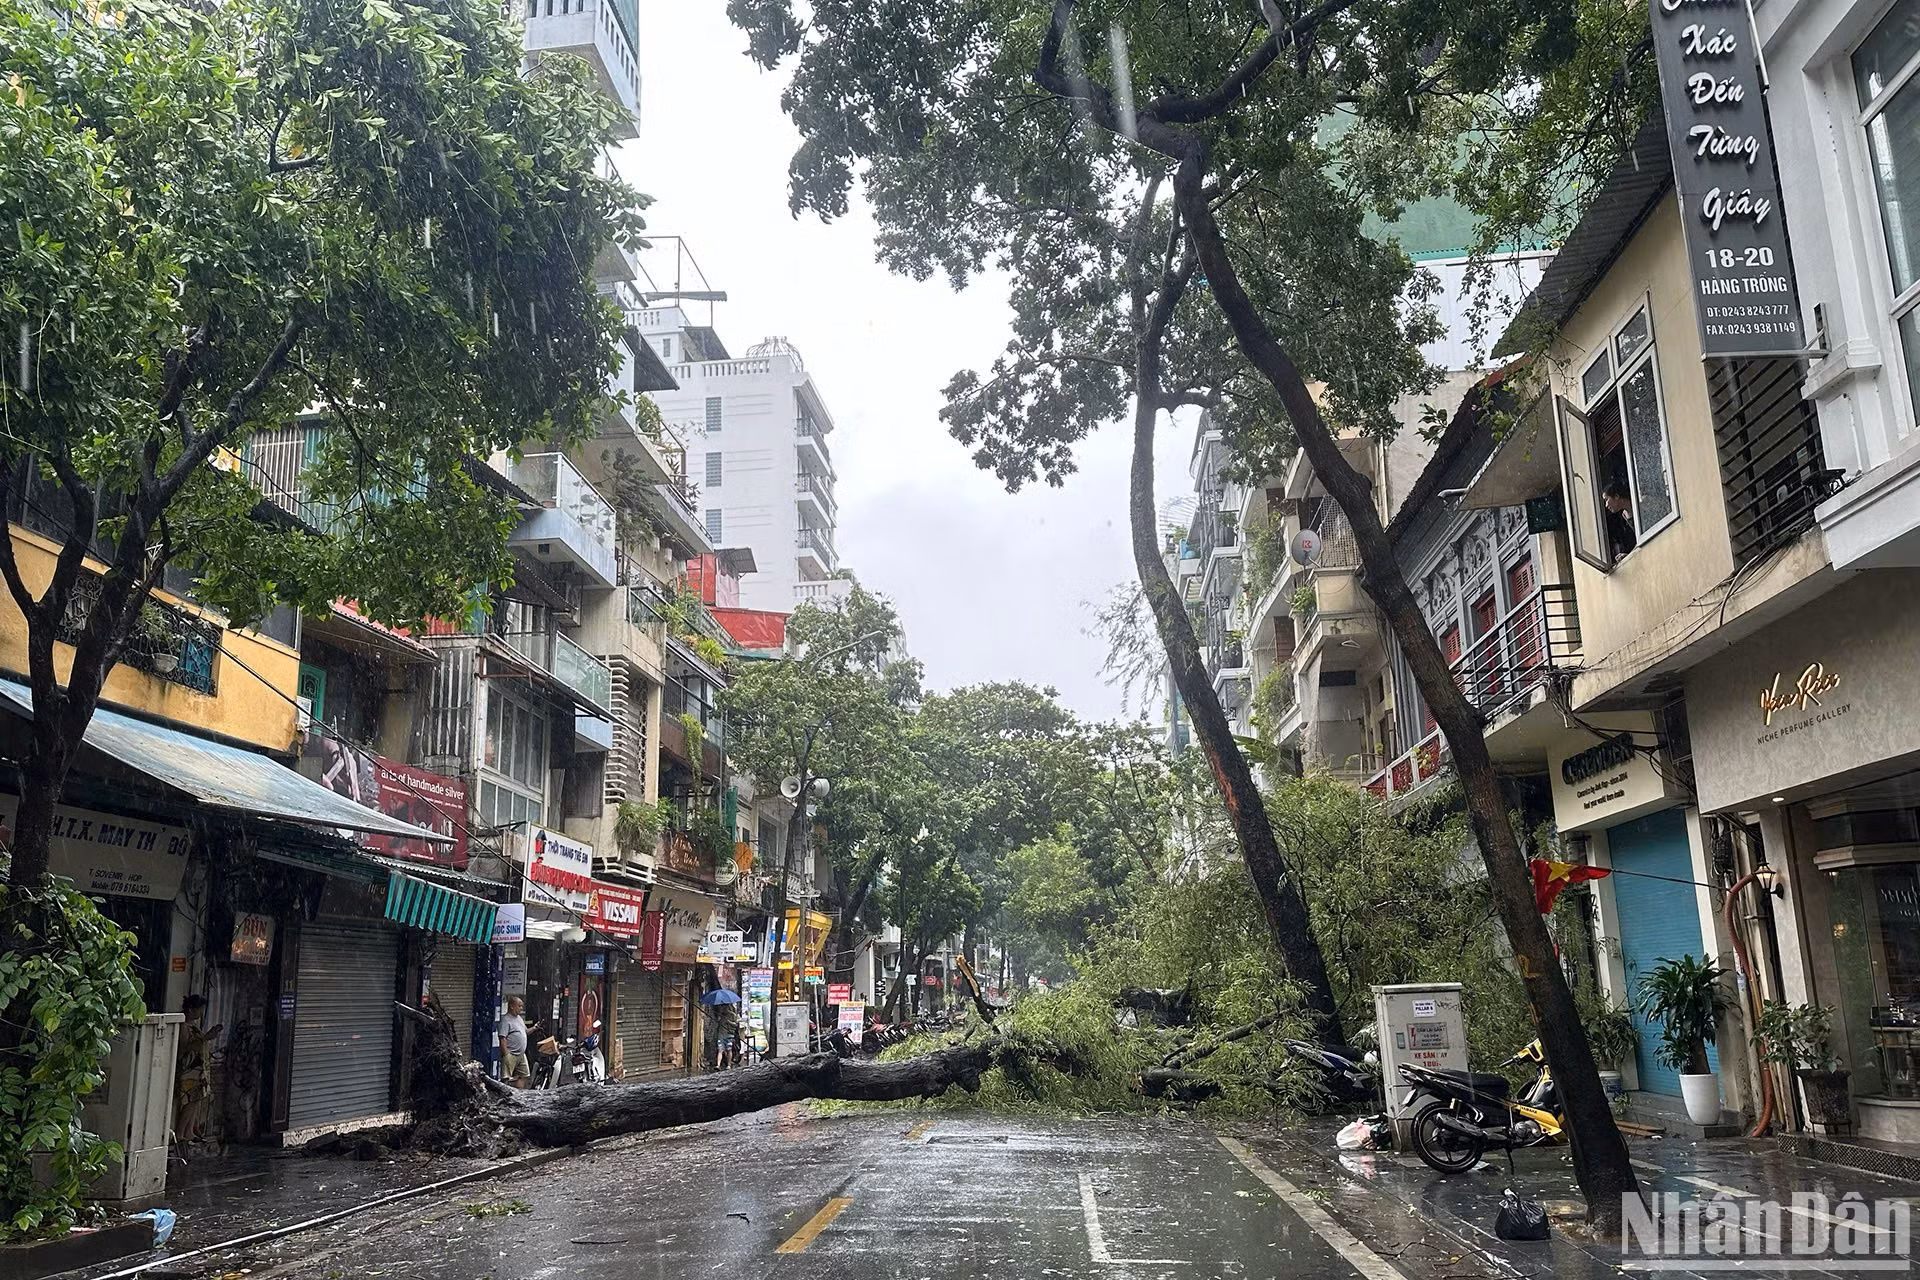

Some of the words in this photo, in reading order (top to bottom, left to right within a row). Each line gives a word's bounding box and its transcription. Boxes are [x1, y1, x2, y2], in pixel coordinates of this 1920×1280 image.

[1681, 24, 1737, 55] Xác
[1688, 72, 1745, 104] Đến
[1689, 124, 1760, 164] Từng
[1703, 187, 1772, 230] Giây
[1705, 247, 1774, 268] 18-20
[1701, 276, 1741, 295] HÀNG
[1742, 271, 1788, 293] TRỐNG
[1722, 306, 1746, 317] 0243
[1747, 305, 1771, 316] 8243
[1773, 304, 1789, 315] 777
[1728, 323, 1752, 335] 0243
[1753, 322, 1772, 333] 938
[1774, 321, 1796, 333] 1149
[1757, 731, 1779, 745] NICHE
[1780, 717, 1814, 737] PERFUME
[1816, 703, 1852, 723] GALLERY
[397, 771, 406, 784] of
[407, 774, 445, 796] handmade
[445, 786, 465, 801] silver
[603, 900, 639, 925] VISSAN
